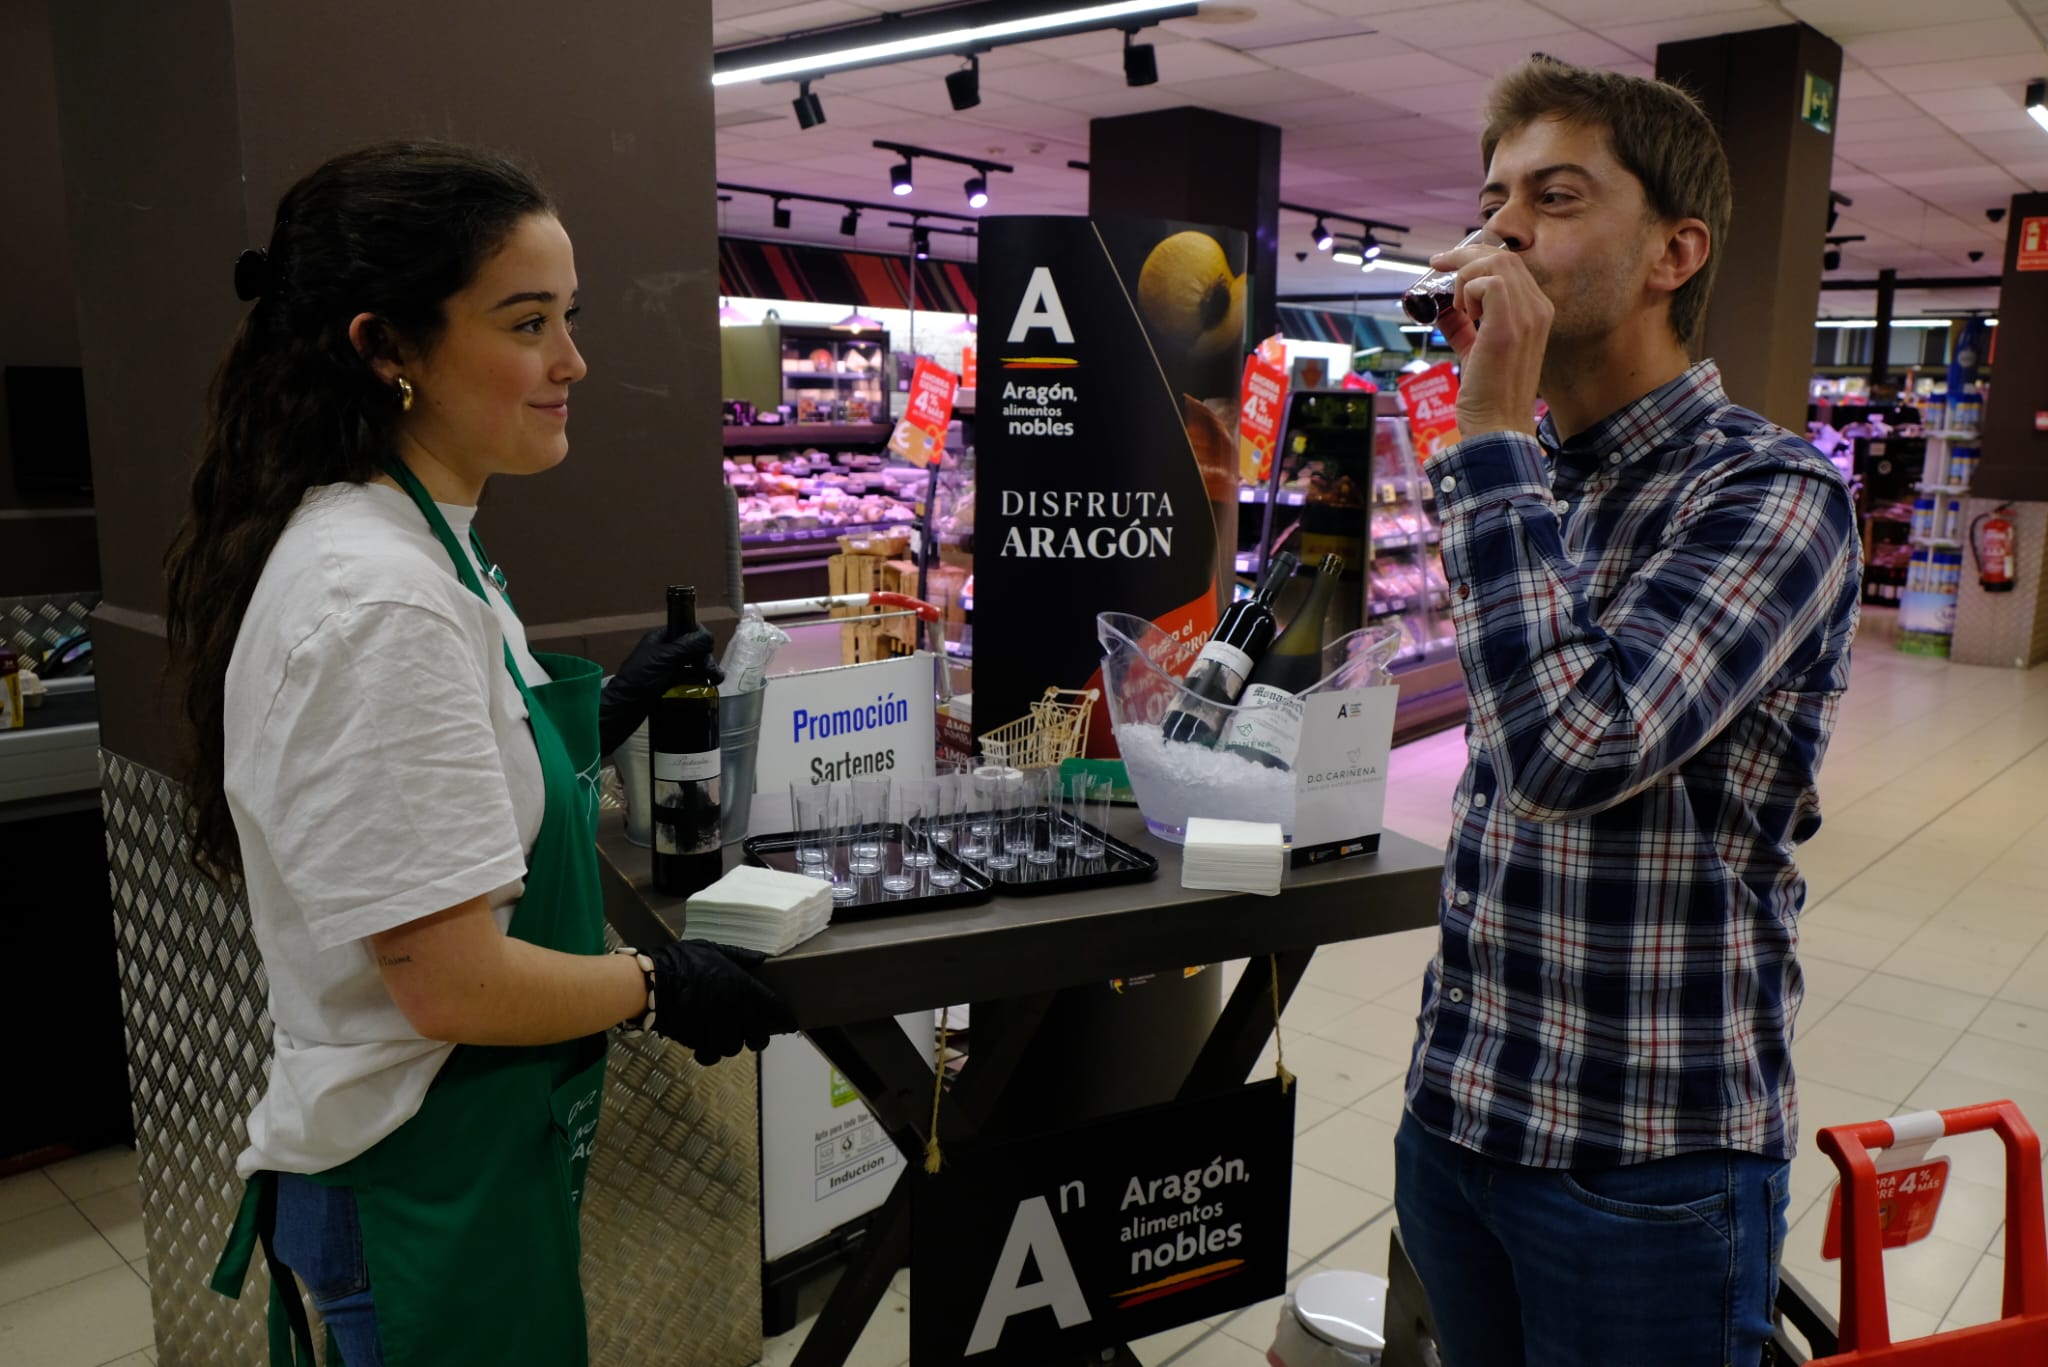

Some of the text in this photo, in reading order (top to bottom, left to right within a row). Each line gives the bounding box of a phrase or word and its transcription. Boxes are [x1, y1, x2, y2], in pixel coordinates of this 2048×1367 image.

[1006, 266, 1076, 344] A
[1002, 381, 1078, 405] Aragón,
[1002, 404, 1062, 417] alimentos
[1008, 418, 1075, 437] nobles
[1001, 490, 1174, 518] DISFRUTA
[1000, 518, 1174, 559] ARAGÓN
[793, 693, 908, 744] Promoción
[811, 749, 895, 786] Sartenes
[830, 1156, 885, 1189] Induction
[1119, 1155, 1250, 1211] Aragón,
[1119, 1201, 1223, 1242] alimentos
[1130, 1223, 1242, 1275] nobles
